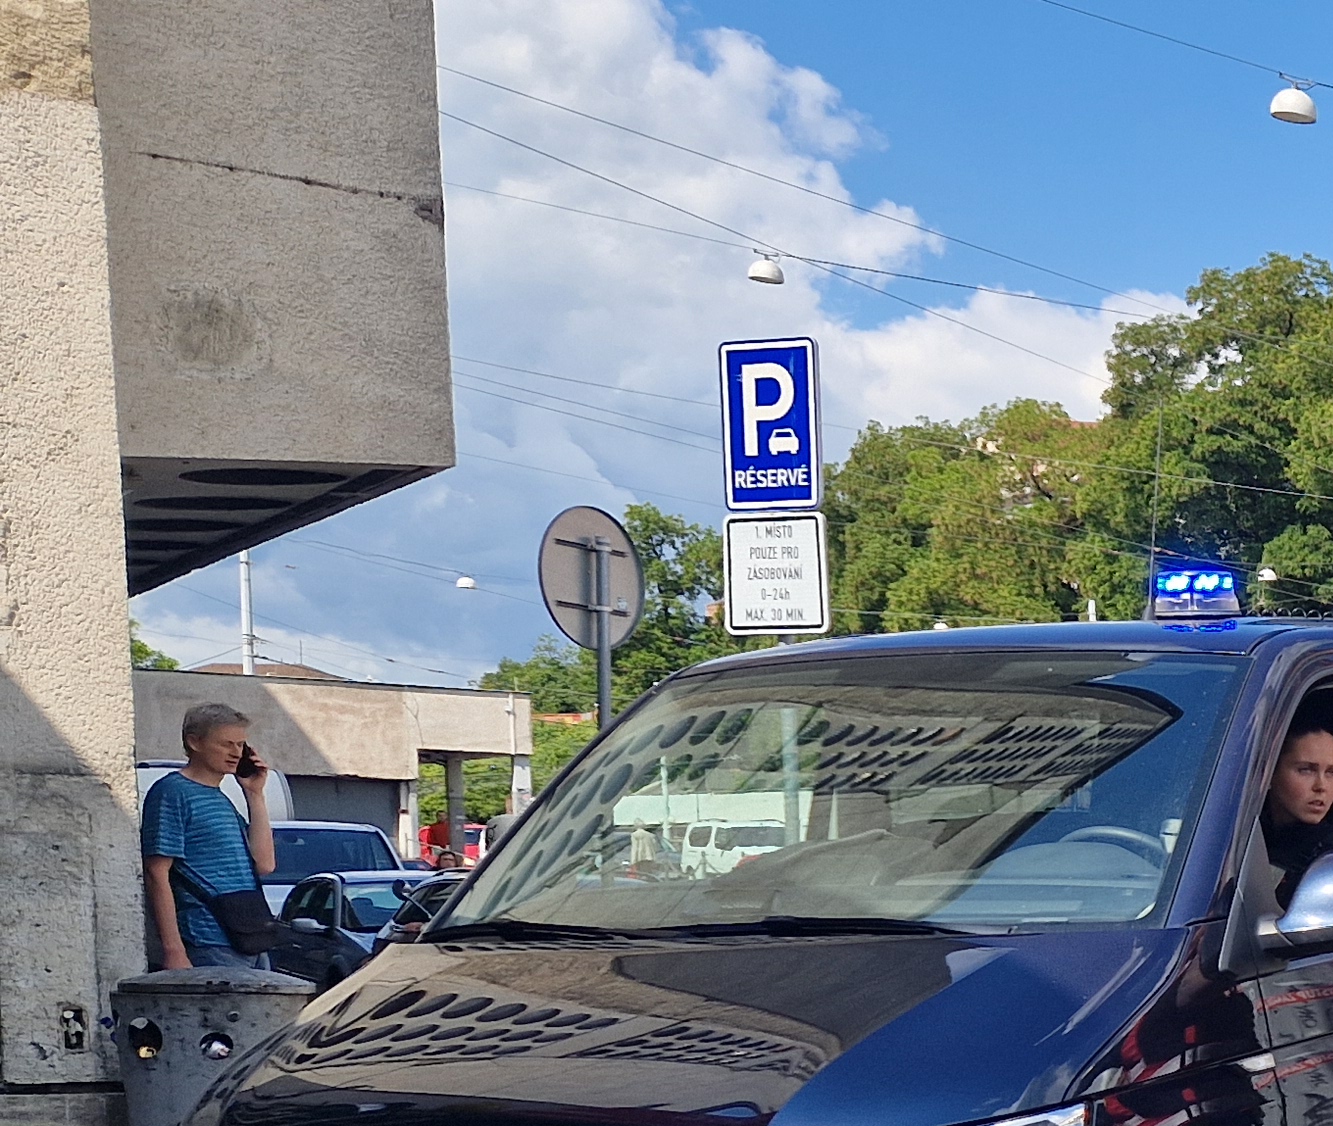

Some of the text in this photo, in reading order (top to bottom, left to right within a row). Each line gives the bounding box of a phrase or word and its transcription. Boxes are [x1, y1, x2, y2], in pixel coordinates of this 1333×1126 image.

[741, 363, 794, 456] P
[766, 522, 793, 539] MÍSTO
[750, 546, 799, 560] POUZE PRO
[771, 608, 782, 621] 30
